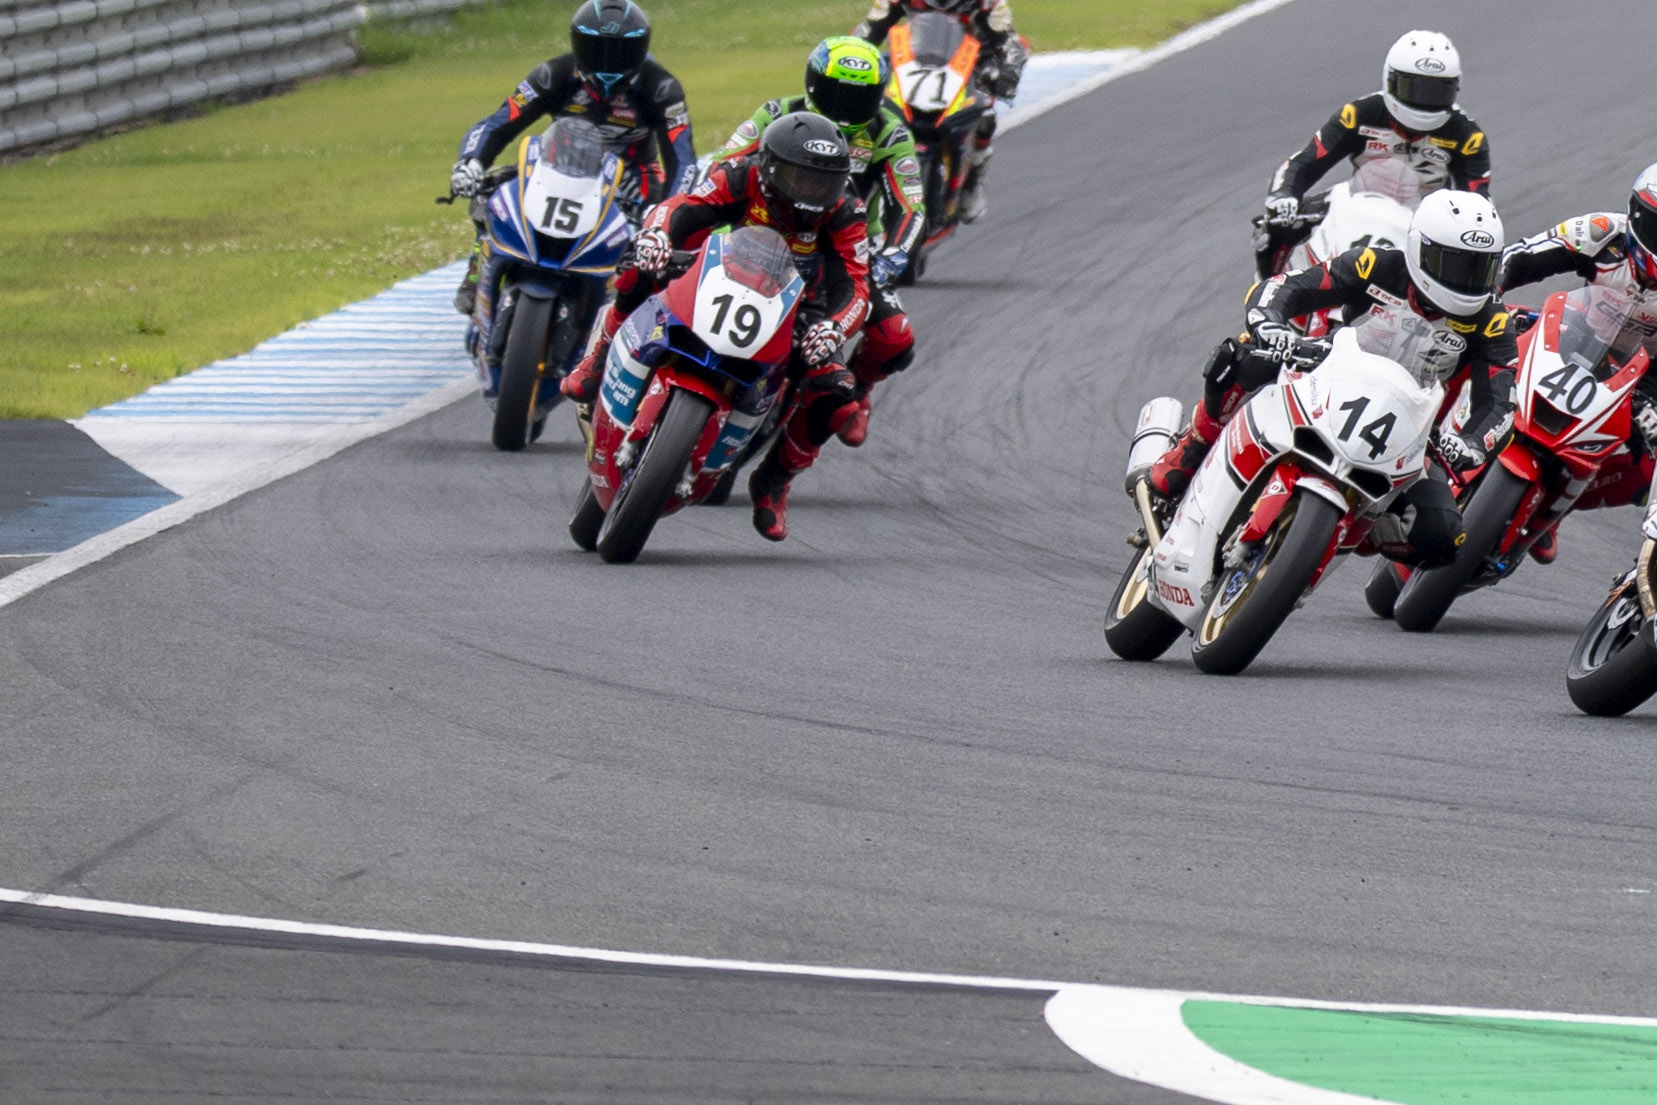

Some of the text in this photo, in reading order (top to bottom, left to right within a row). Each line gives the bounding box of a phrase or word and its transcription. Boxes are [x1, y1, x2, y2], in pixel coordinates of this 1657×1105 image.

[1416, 59, 1444, 71] Arai
[906, 69, 947, 106] 71
[541, 197, 583, 234] 15
[1462, 231, 1494, 246] Arai
[709, 294, 762, 348] 19
[1436, 330, 1465, 350] Arai
[1538, 363, 1598, 415] 40
[1337, 396, 1398, 461] 14
